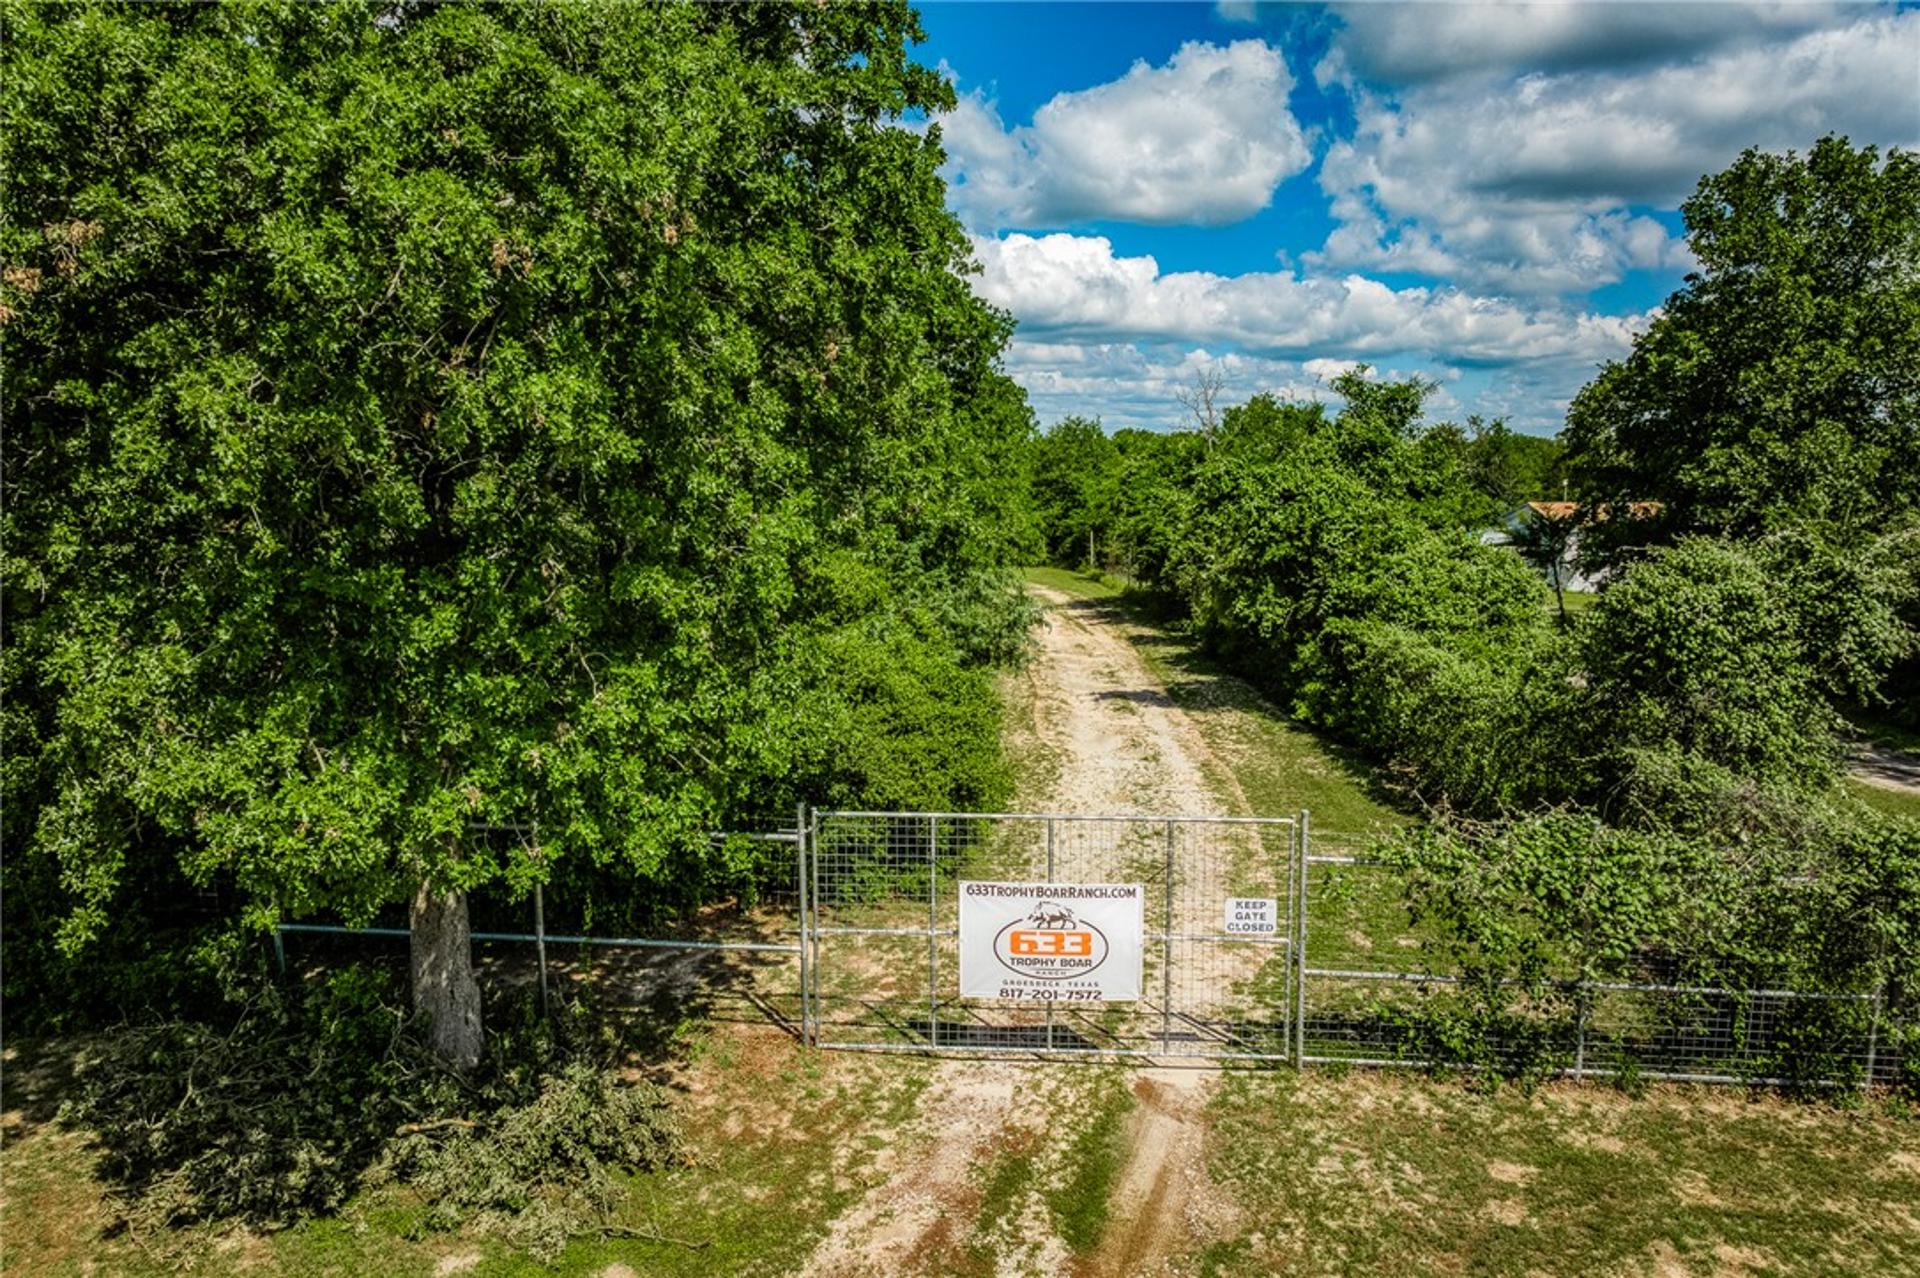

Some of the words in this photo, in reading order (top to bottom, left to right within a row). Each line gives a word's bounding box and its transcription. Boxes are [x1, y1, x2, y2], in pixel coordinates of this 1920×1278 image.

[1235, 901, 1267, 909] KEEP
[1235, 912, 1267, 921] GATE
[1227, 922, 1274, 932] CLOSED
[1010, 930, 1092, 956] 633
[1010, 957, 1057, 967] TROPHY
[1060, 958, 1092, 968] BOAR
[999, 988, 1102, 1001] 817-201-7572
